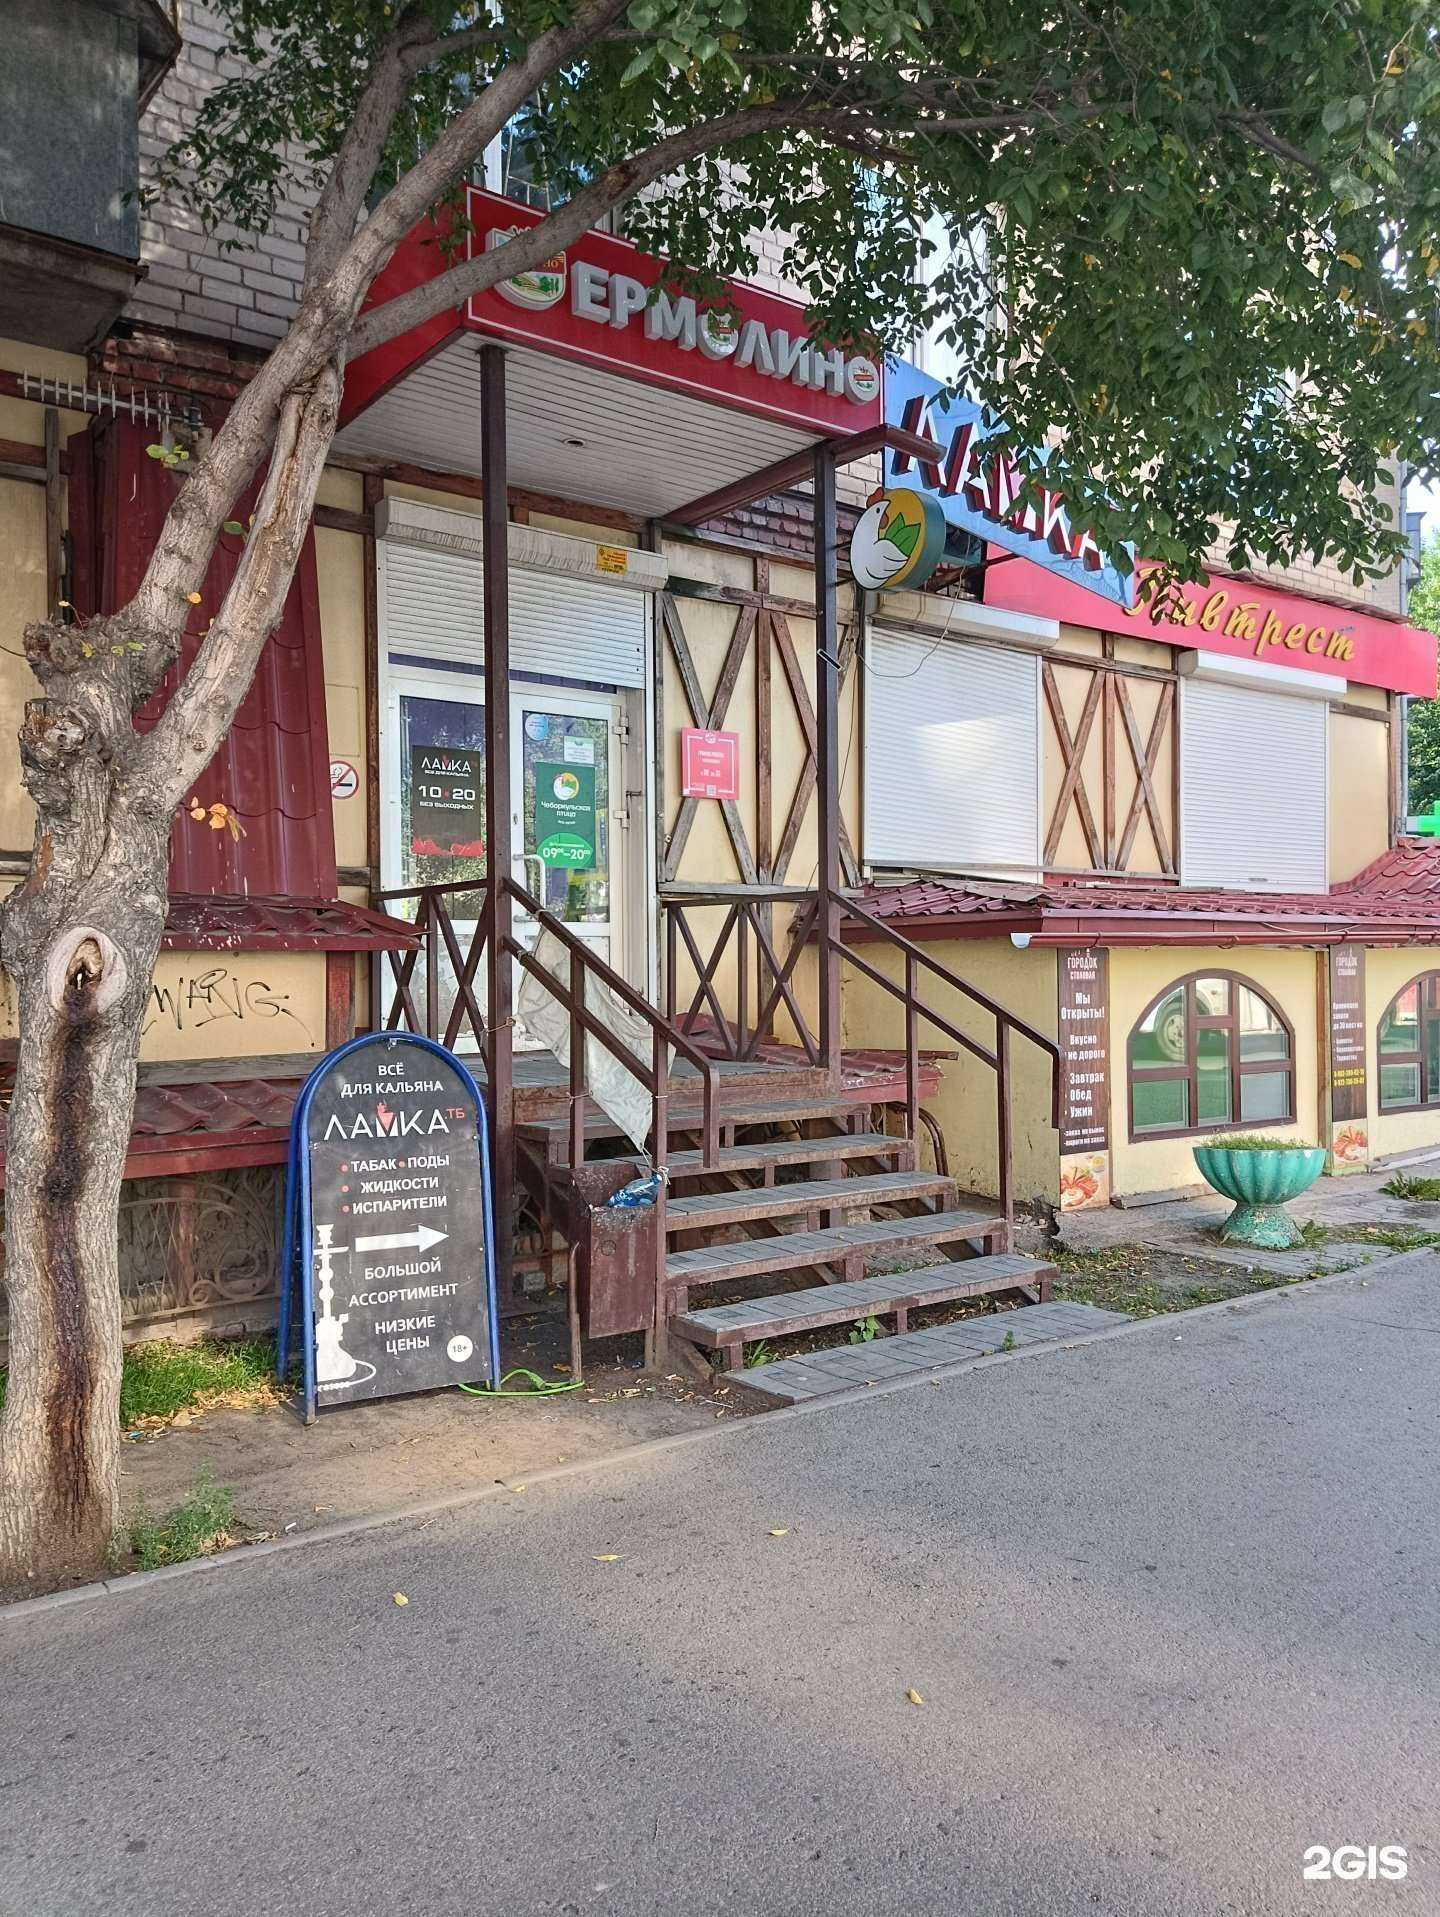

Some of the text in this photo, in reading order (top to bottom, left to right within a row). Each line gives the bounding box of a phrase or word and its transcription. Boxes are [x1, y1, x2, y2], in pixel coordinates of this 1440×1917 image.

[418, 785, 476, 801] 10 20
[1067, 957, 1098, 970] ГОРОДОК
[1075, 992, 1091, 1005] Мы
[1061, 1006, 1105, 1020] Открыты!
[1070, 1034, 1097, 1046] Вкусно
[378, 1062, 404, 1076] ВСЁ
[1070, 1072, 1105, 1085] Завтрак
[340, 1080, 444, 1098] ДЛЯ КАЛЬЯНА
[1070, 1089, 1092, 1101] Обед
[1070, 1105, 1093, 1118] Ужин
[351, 1155, 450, 1173] ТАБАК ПОДЫ
[360, 1177, 439, 1194] ЖИДКОСТИ
[352, 1195, 447, 1215] ИСПАРИТЕЛИ
[364, 1256, 442, 1280] БОЛЬШОЙ
[348, 1283, 459, 1307] АССОРТИМЕНТ
[375, 1315, 436, 1335] НИЗКИЕ
[386, 1336, 430, 1355] ЦЕНЫ
[452, 1345, 467, 1354] 18+
